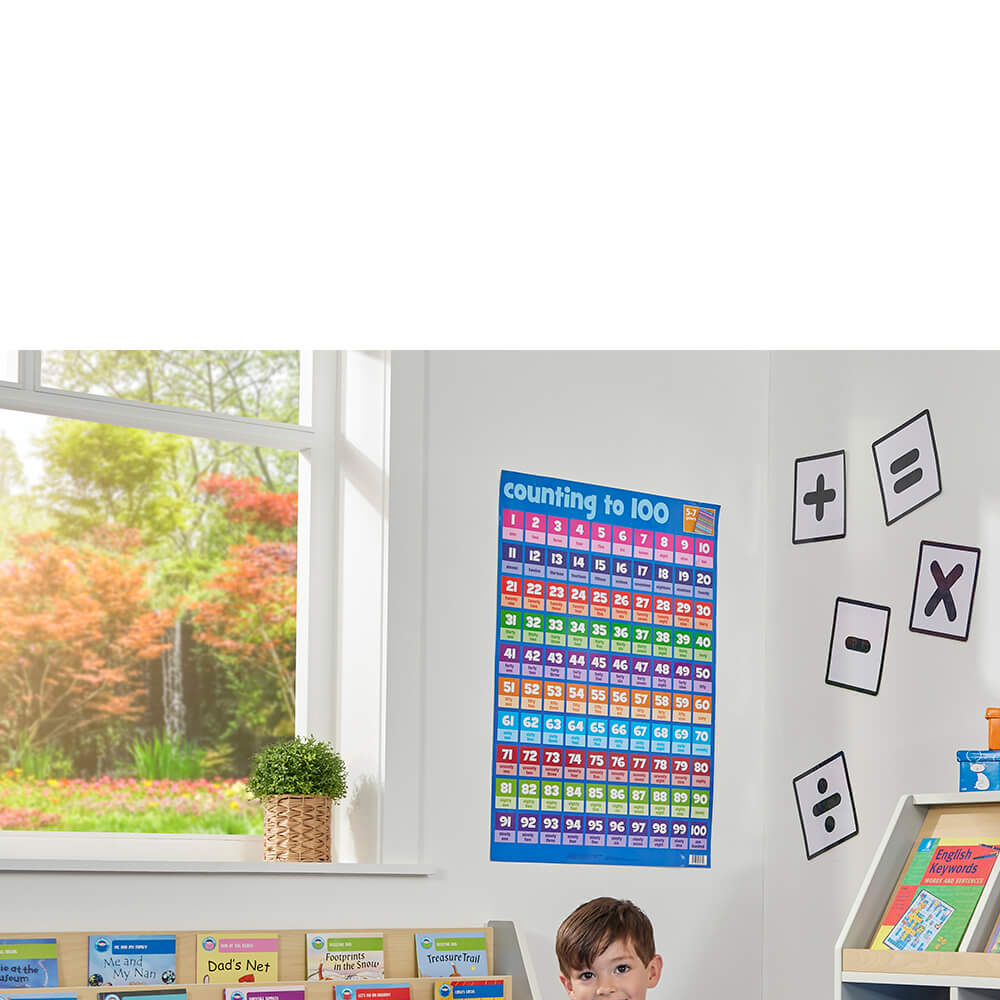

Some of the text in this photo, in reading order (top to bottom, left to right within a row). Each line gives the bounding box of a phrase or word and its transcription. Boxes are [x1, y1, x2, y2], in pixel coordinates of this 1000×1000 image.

[503, 481, 669, 524] counting to 100
[510, 514, 516, 525] 1
[531, 517, 540, 528] 2
[554, 520, 562, 531] 3
[575, 524, 584, 535] 4
[598, 527, 605, 538] 5
[619, 530, 626, 541] 6
[640, 534, 648, 544] 7
[660, 537, 668, 547] 8
[681, 540, 688, 550] 9
[699, 542, 710, 553] 10
[936, 849, 973, 862] English
[929, 863, 978, 876] Keywords
[104, 956, 142, 968] Me and
[326, 952, 365, 962] Footprints
[427, 953, 480, 964] Treasure Trail
[208, 959, 270, 972] Dad's Net
[334, 960, 379, 970] in the Snow
[113, 968, 156, 981] My Nan
